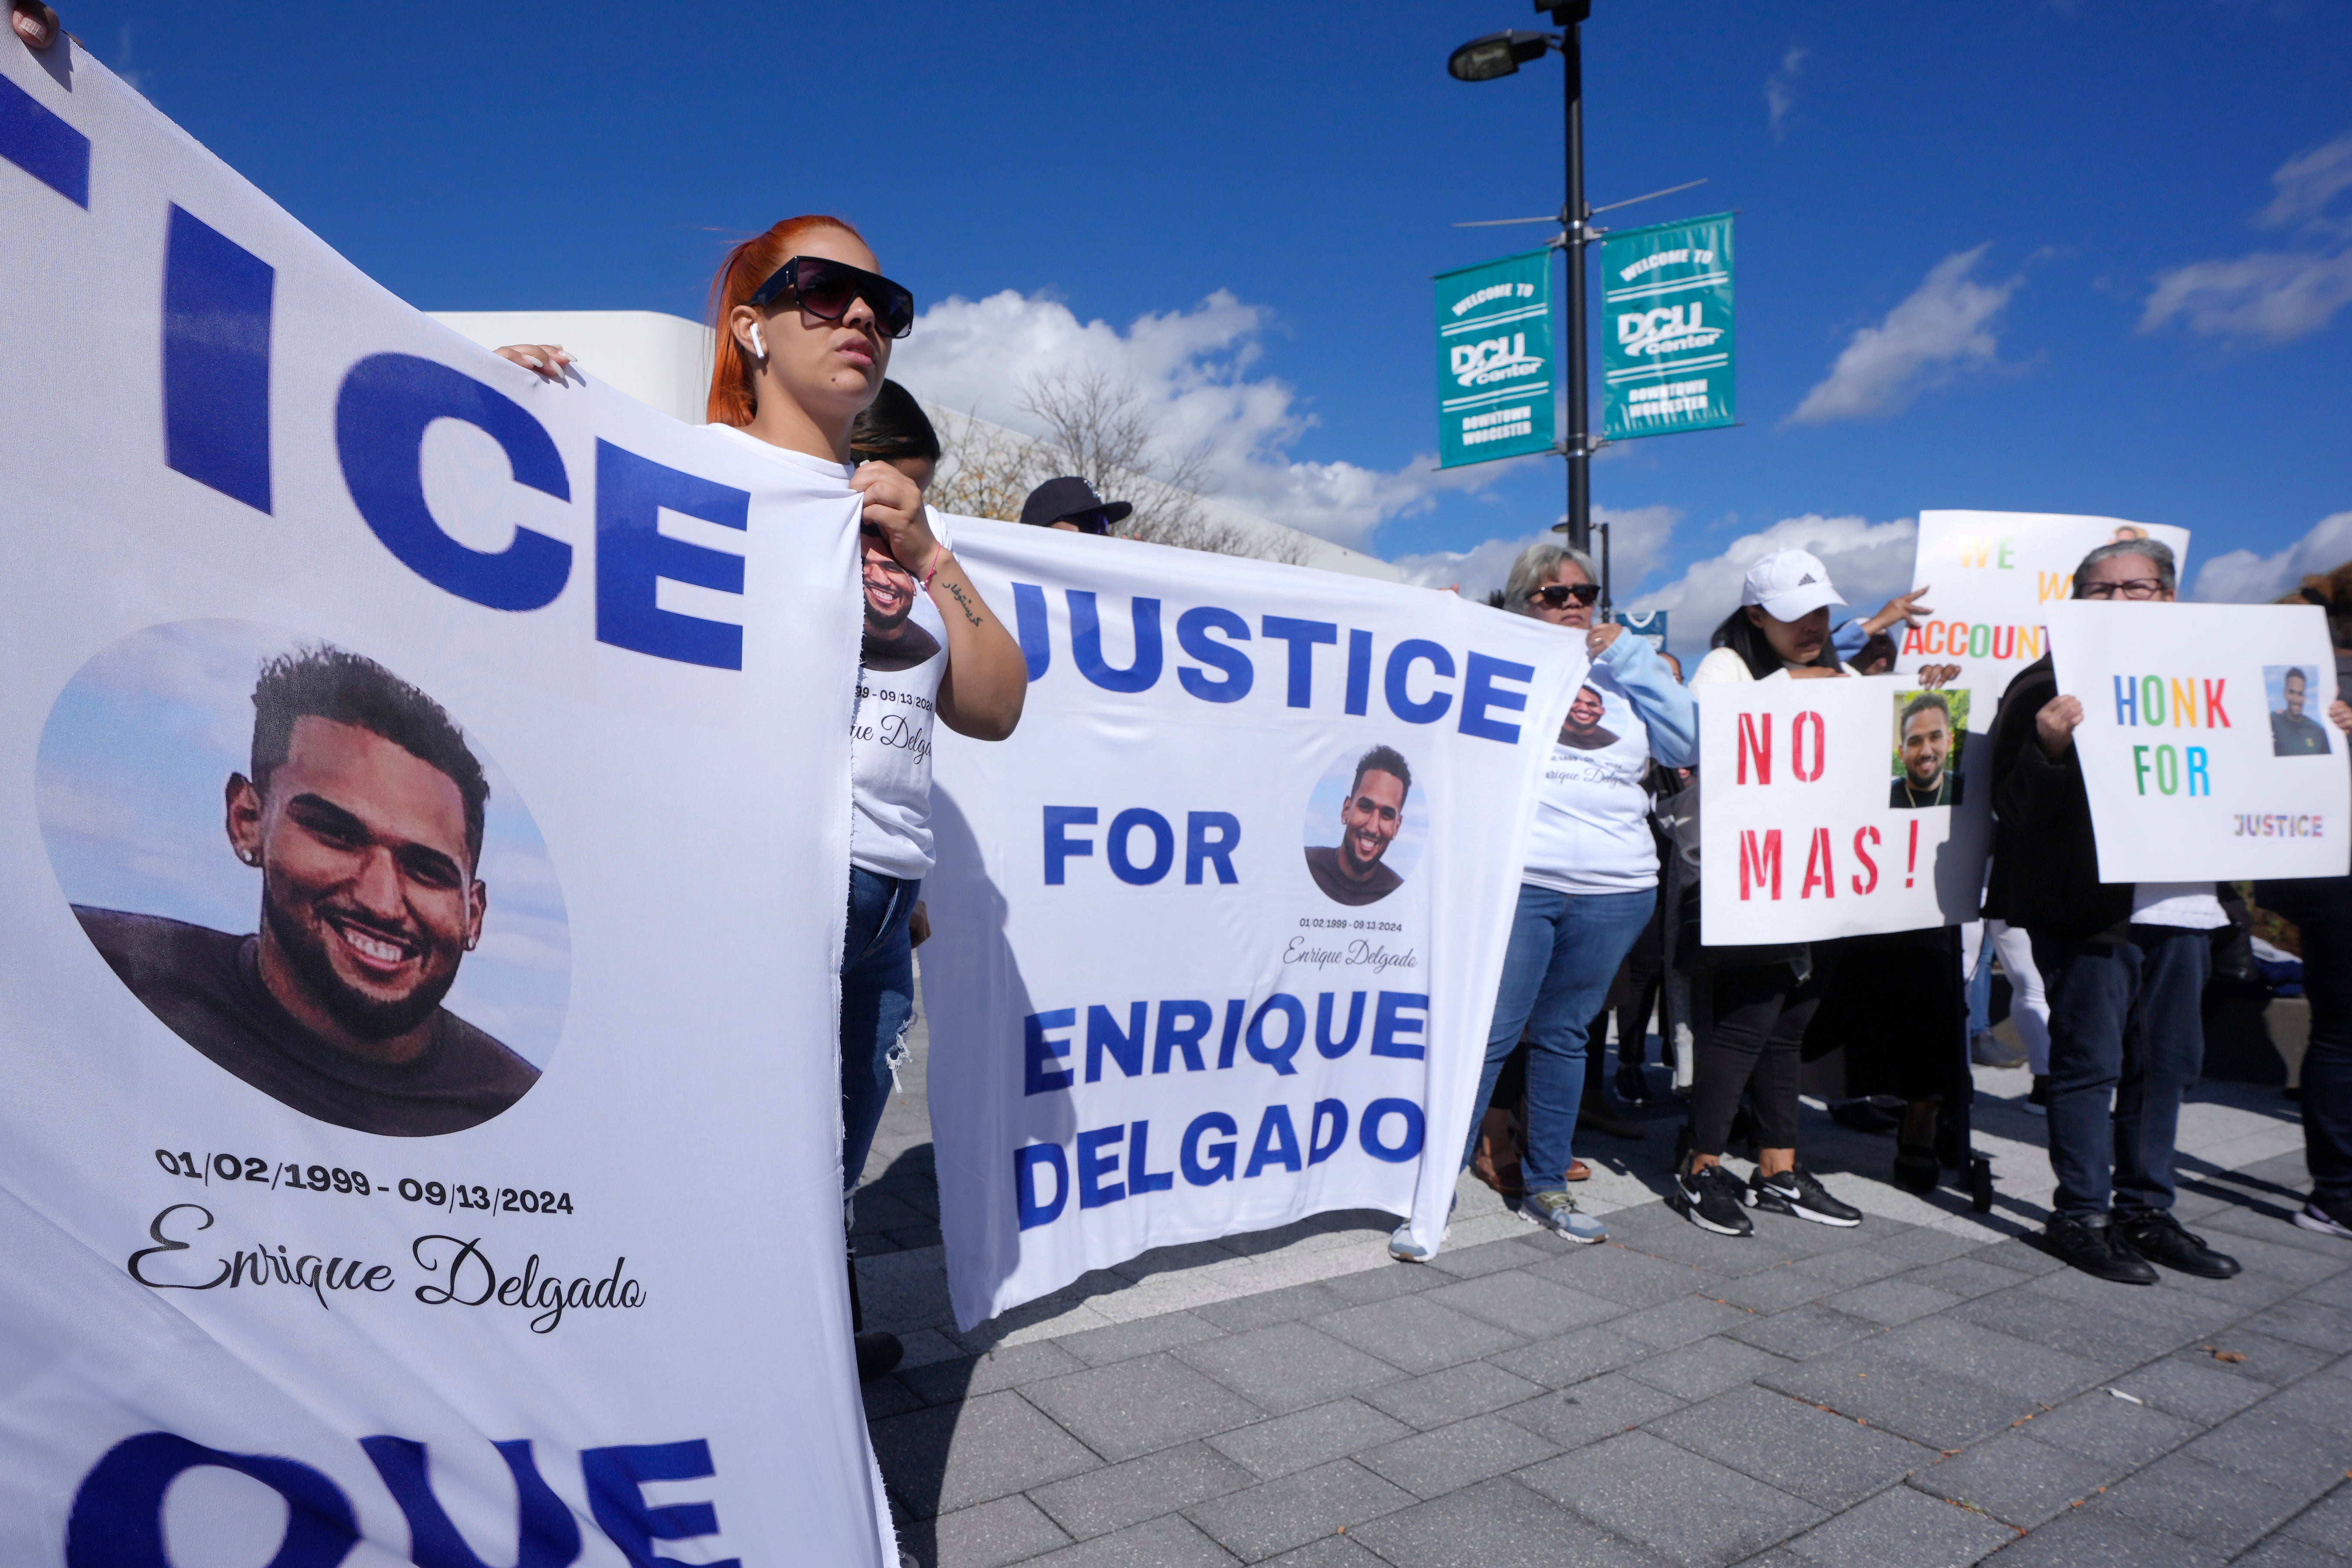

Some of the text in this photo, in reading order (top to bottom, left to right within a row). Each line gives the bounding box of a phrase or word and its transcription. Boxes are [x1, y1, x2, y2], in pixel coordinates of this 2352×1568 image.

[1619, 248, 1713, 282] WELCOME TO
[1452, 283, 1534, 316] WELCOME TO
[1618, 301, 1702, 345] DCU
[1450, 332, 1525, 375] DCU
[1628, 378, 1708, 403] DOWNTOWN
[1628, 394, 1708, 418] WORCESTER
[1462, 405, 1531, 431] DOWNTOWN
[1462, 421, 1532, 446] WORCESTER
[1957, 535, 2015, 569] WE
[1011, 581, 1535, 744] JUSTICE
[2113, 675, 2231, 728] HONK
[1737, 711, 1825, 785] NO
[2133, 744, 2210, 796] FOR
[1043, 805, 1241, 886] FOR
[2233, 814, 2324, 837] JUSTICE
[1283, 936, 1418, 974] Enrique Delgado
[1024, 990, 1429, 1097] ENRIQUE
[155, 1149, 370, 1196] 01/02/1999
[397, 1178, 574, 1217] 09/13/2024
[1014, 1097, 1426, 1232] DELGADO
[128, 1203, 646, 1334] Enrique Delgado
